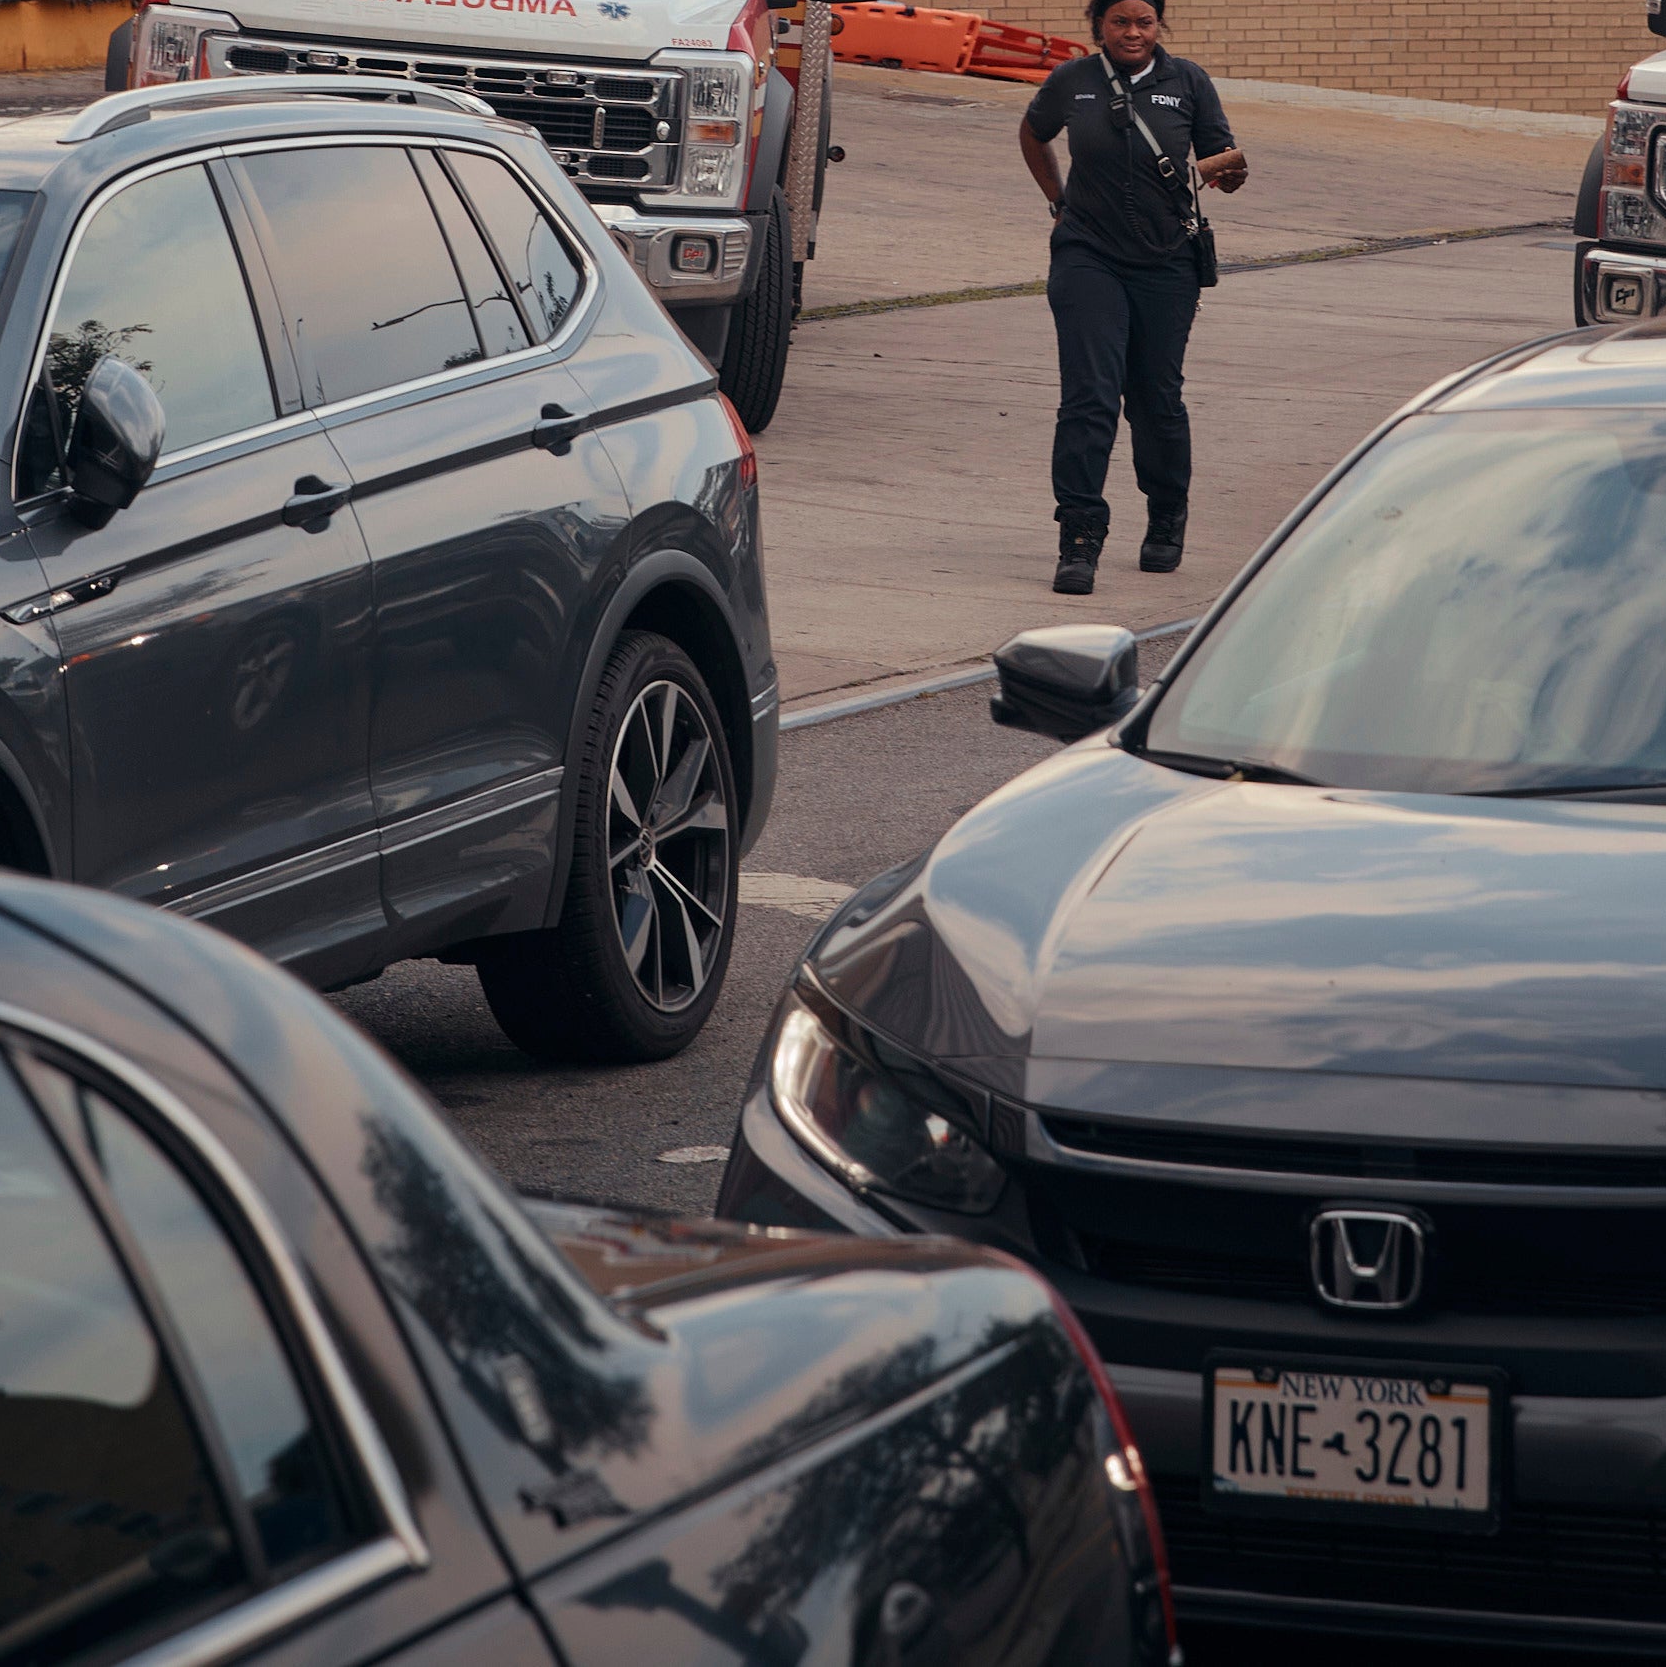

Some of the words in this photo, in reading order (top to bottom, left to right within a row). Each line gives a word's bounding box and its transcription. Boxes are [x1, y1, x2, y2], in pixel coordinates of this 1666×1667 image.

[1151, 93, 1182, 108] FDNY
[1281, 1372, 1344, 1401] NEW
[1351, 1378, 1427, 1407] YORK
[1229, 1400, 1319, 1479] KNE
[1355, 1409, 1468, 1491] 3281
